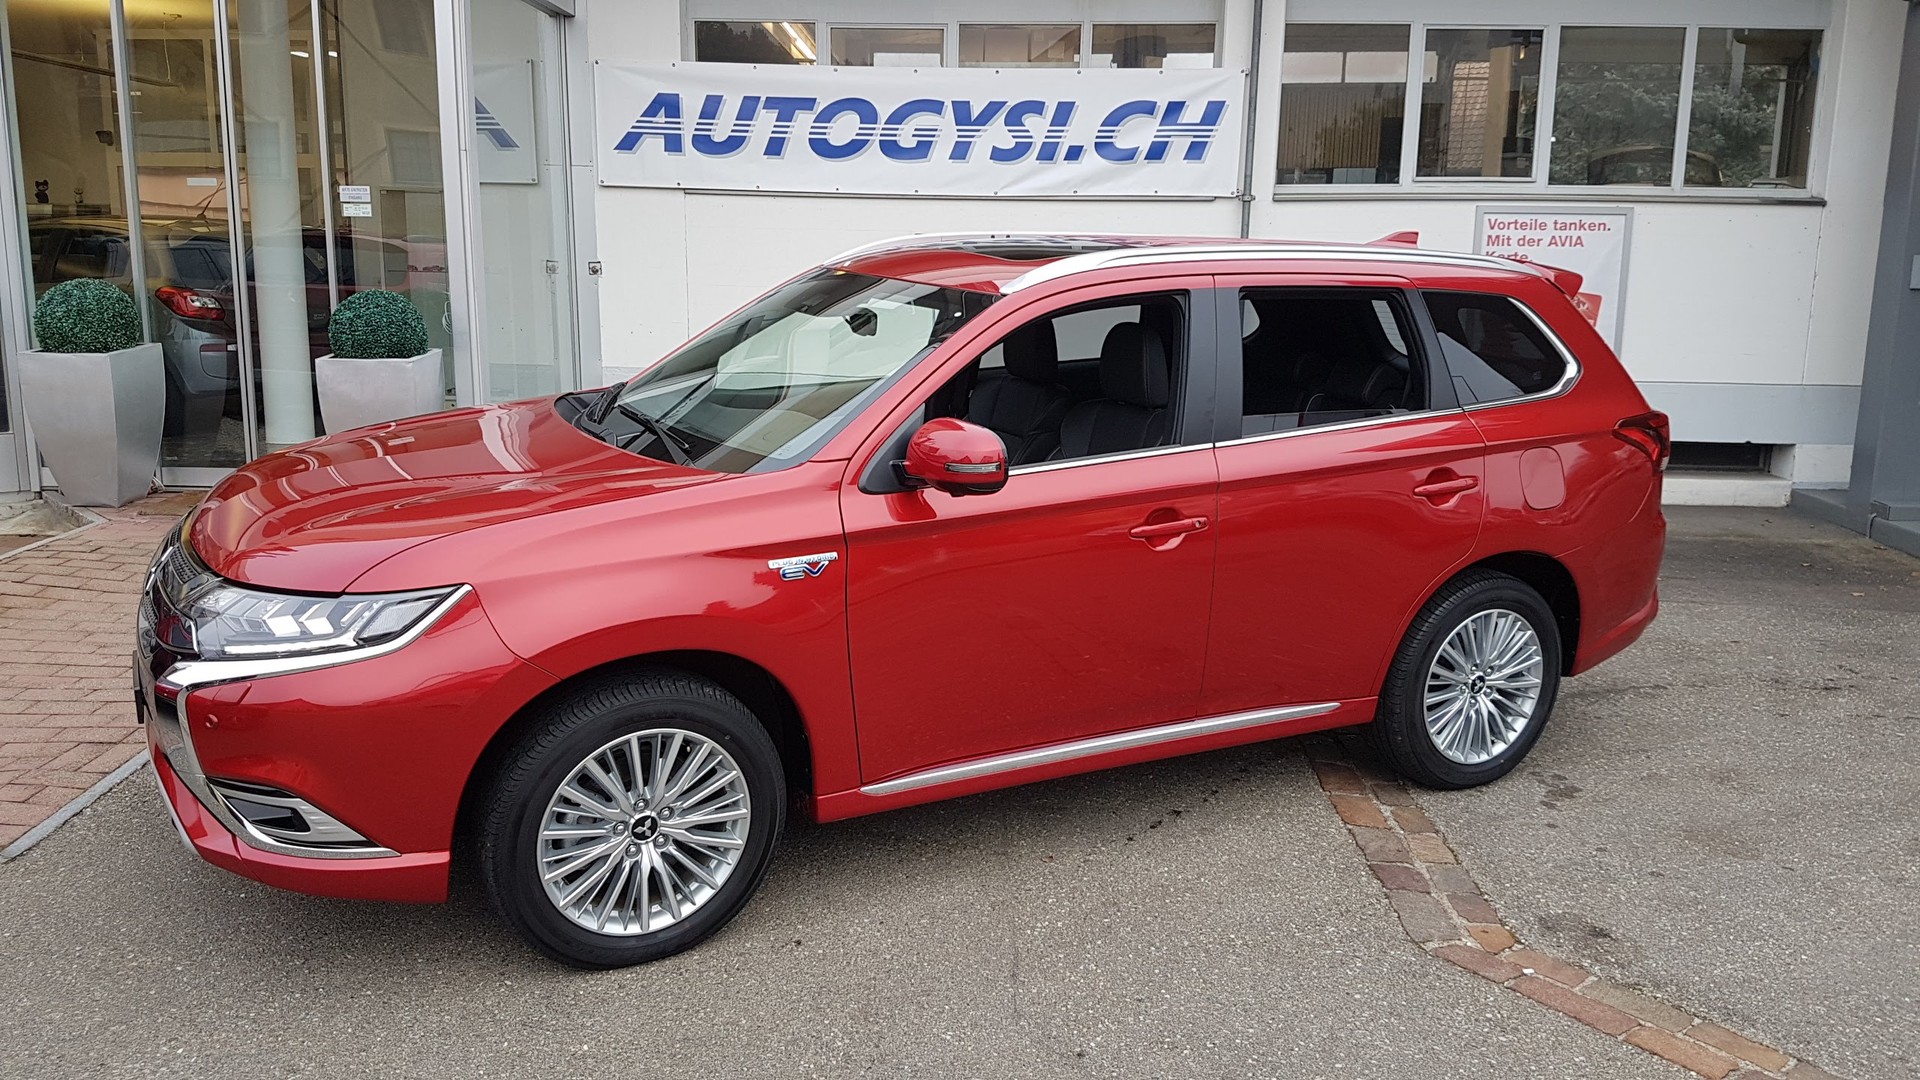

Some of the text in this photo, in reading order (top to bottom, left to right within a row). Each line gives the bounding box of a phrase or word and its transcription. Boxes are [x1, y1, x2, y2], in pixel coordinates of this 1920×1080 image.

[613, 92, 1229, 164] AUTOGYSI.CH
[1487, 218, 1611, 231] Vorteile tanken.
[1486, 234, 1584, 247] Mit der AVIA
[780, 561, 829, 581] EV
